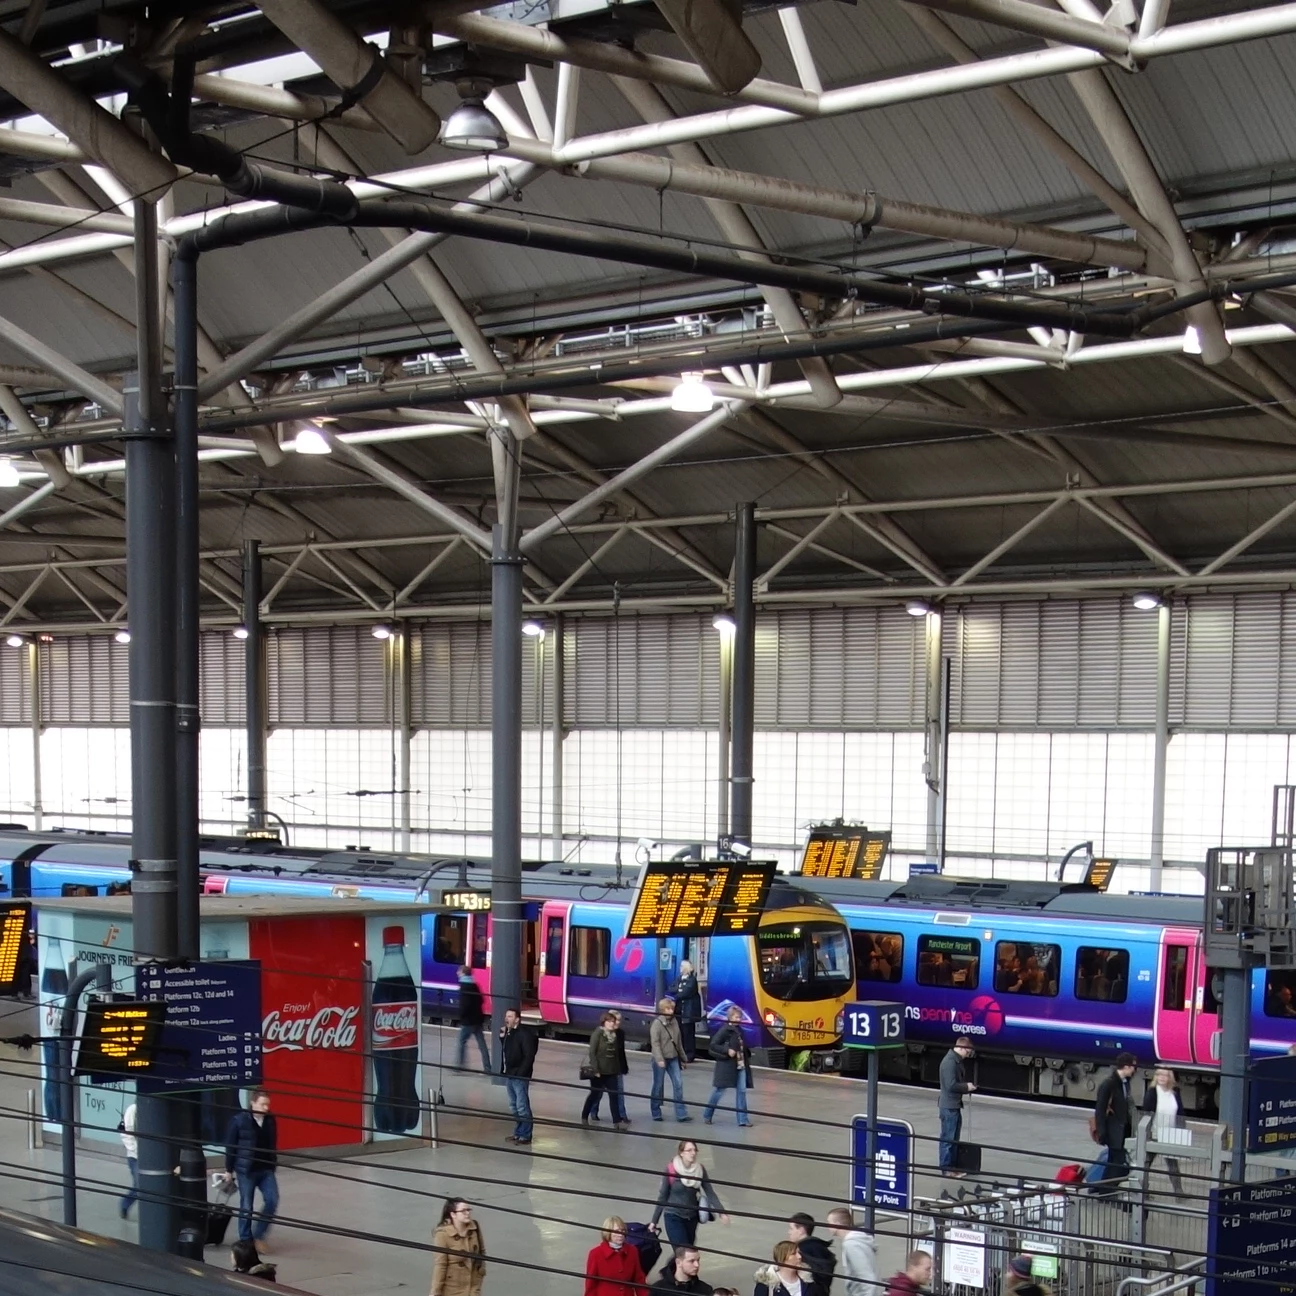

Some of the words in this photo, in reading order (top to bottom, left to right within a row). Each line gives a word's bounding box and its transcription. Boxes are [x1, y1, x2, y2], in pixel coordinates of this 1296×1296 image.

[444, 893, 478, 910] 1153
[282, 1002, 312, 1014] Enjoy!
[373, 1006, 417, 1032] Coca-Cola
[799, 1020, 814, 1029] First
[849, 1011, 871, 1037] 13
[881, 1012, 901, 1038] 13
[261, 1006, 360, 1054] Coca-Cola
[951, 1023, 987, 1036] express
[218, 1034, 237, 1042] Ladies
[201, 1048, 226, 1056] Platform
[202, 1060, 227, 1069] Platform
[85, 1092, 106, 1112] Toys
[882, 1194, 899, 1205] Point
[1246, 1242, 1280, 1256] Platforms
[1280, 1239, 1289, 1249] 14
